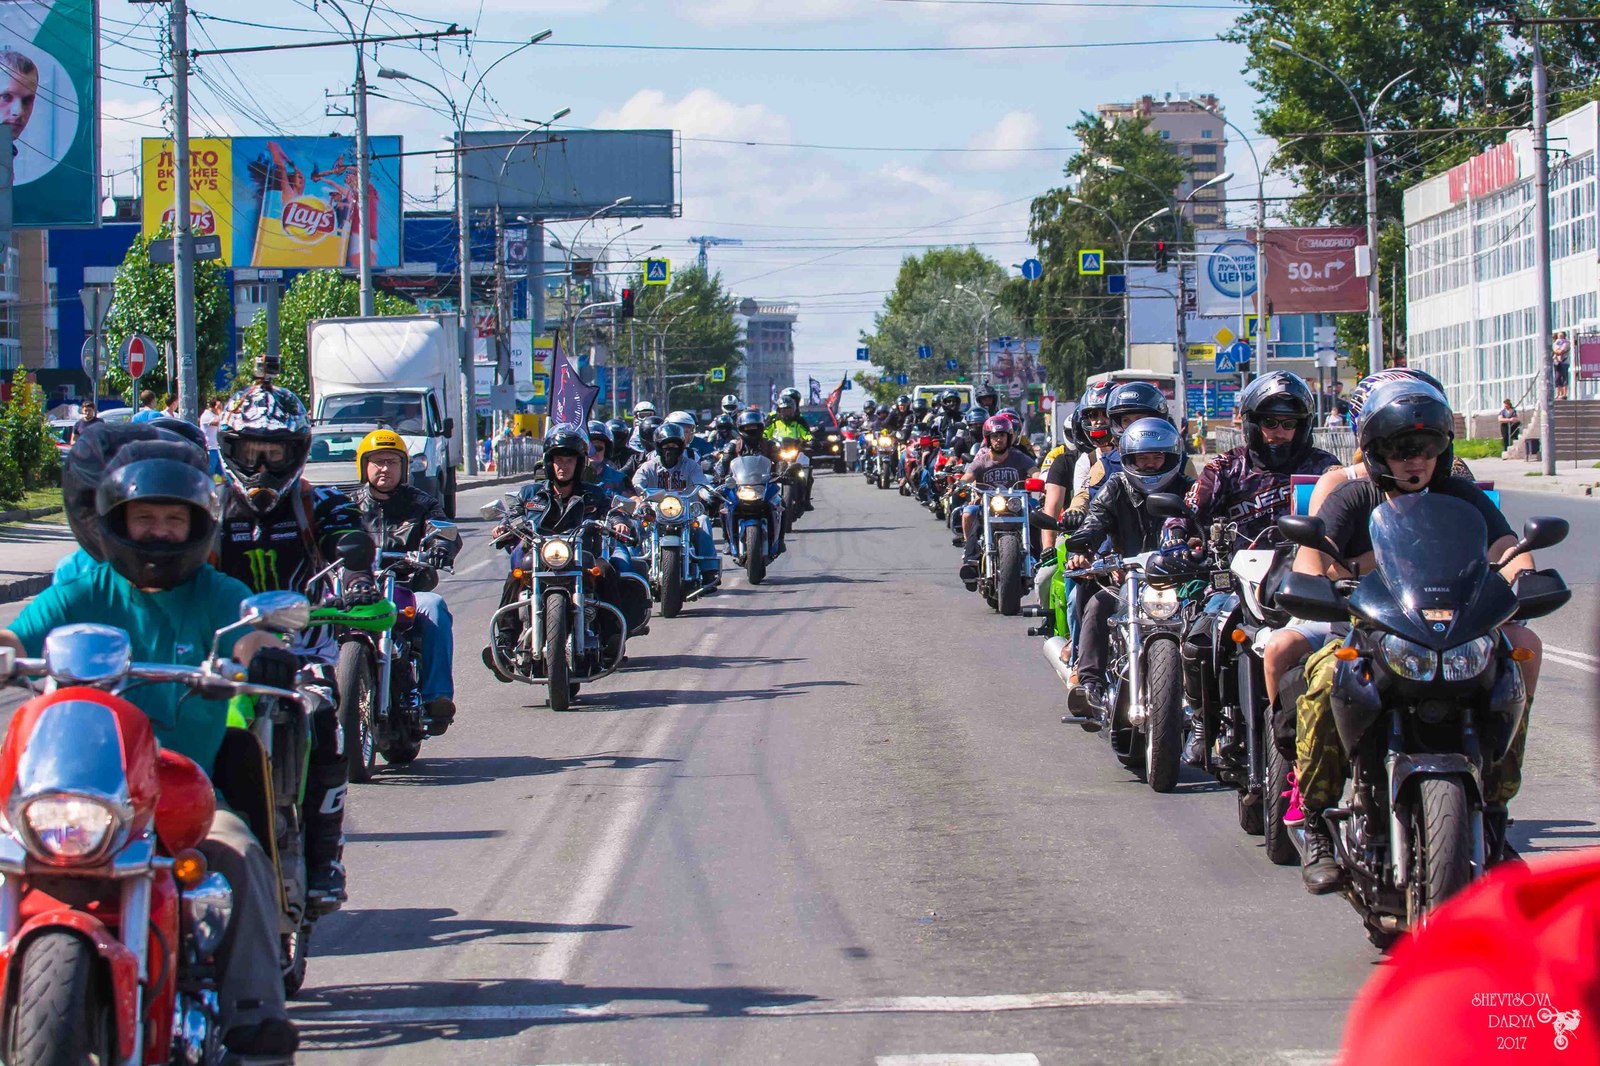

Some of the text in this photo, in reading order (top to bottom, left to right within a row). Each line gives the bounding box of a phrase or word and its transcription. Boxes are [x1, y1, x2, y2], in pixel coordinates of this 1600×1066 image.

[157, 150, 219, 167] ЛТО
[157, 168, 219, 178] ВКНЕЕ
[1218, 272, 1256, 284] ЦЕНЫ
[1287, 262, 1313, 280] 50
